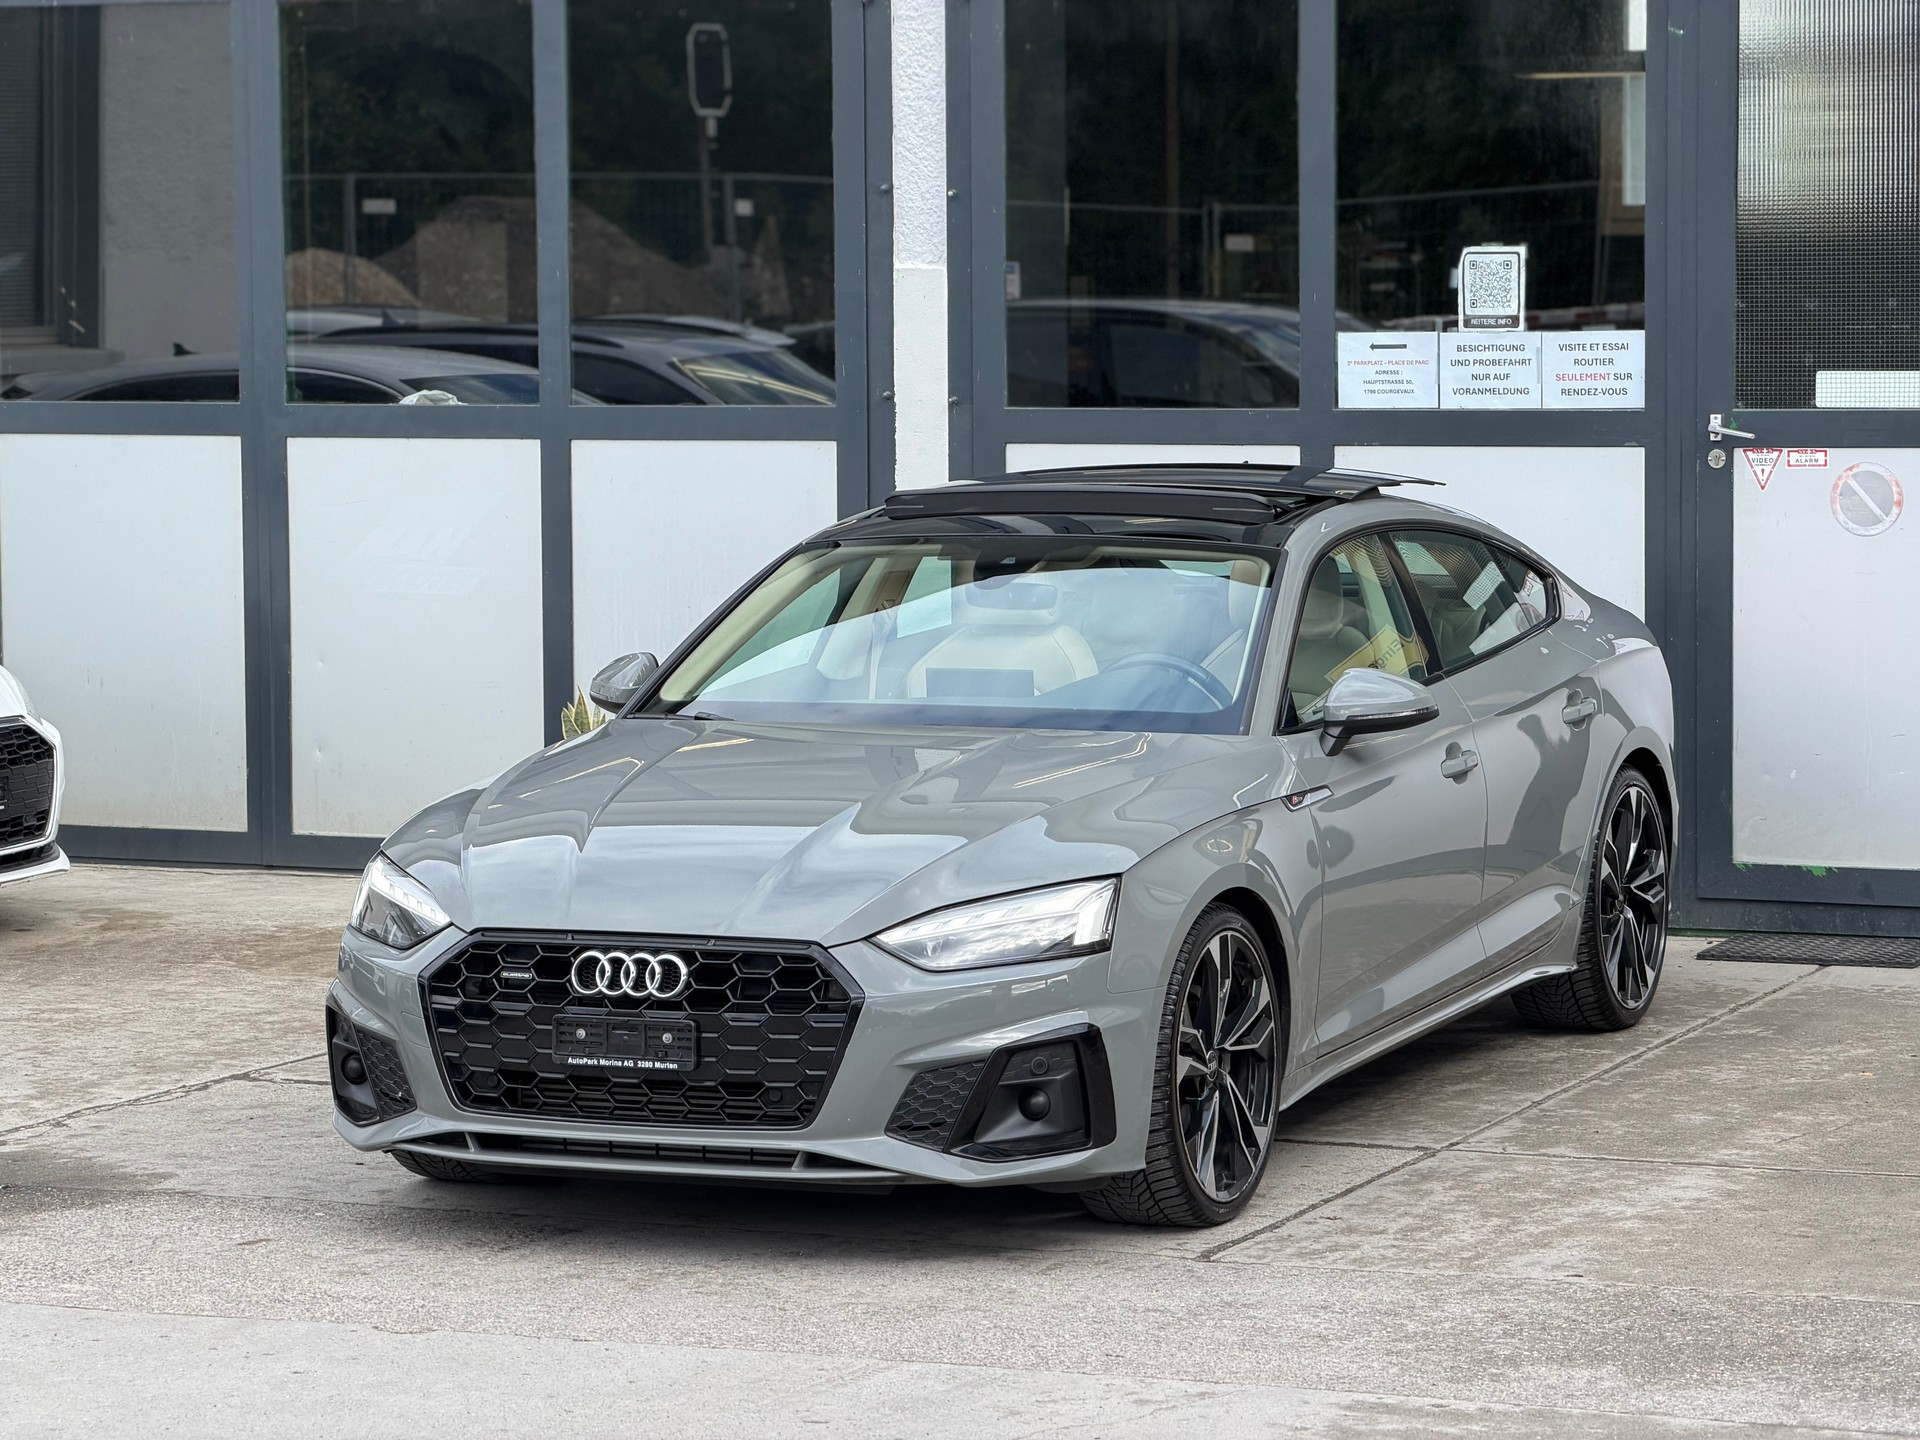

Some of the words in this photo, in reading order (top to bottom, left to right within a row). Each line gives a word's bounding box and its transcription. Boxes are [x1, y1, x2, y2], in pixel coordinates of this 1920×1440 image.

[1497, 317, 1512, 325] INFO
[1456, 344, 1526, 352] BESICHTIGUNG
[1558, 343, 1587, 352] VISITE
[1589, 343, 1600, 351] ET
[1602, 342, 1629, 351] ESSAI
[1450, 359, 1471, 367] UND
[1472, 358, 1532, 367] PROBEFAHRT
[1573, 358, 1614, 366] ROUTIER
[1471, 373, 1491, 381] NUR
[1492, 373, 1511, 381] AUF
[1555, 373, 1611, 382] SEULEMENT
[1613, 373, 1633, 381] SUR
[1452, 387, 1530, 395] VORANMELDUNG
[1560, 387, 1628, 396] RENDEZ-VOUS
[567, 1057, 598, 1065] AutoPark
[599, 1059, 621, 1067] Morina
[654, 1061, 678, 1069] Murten
